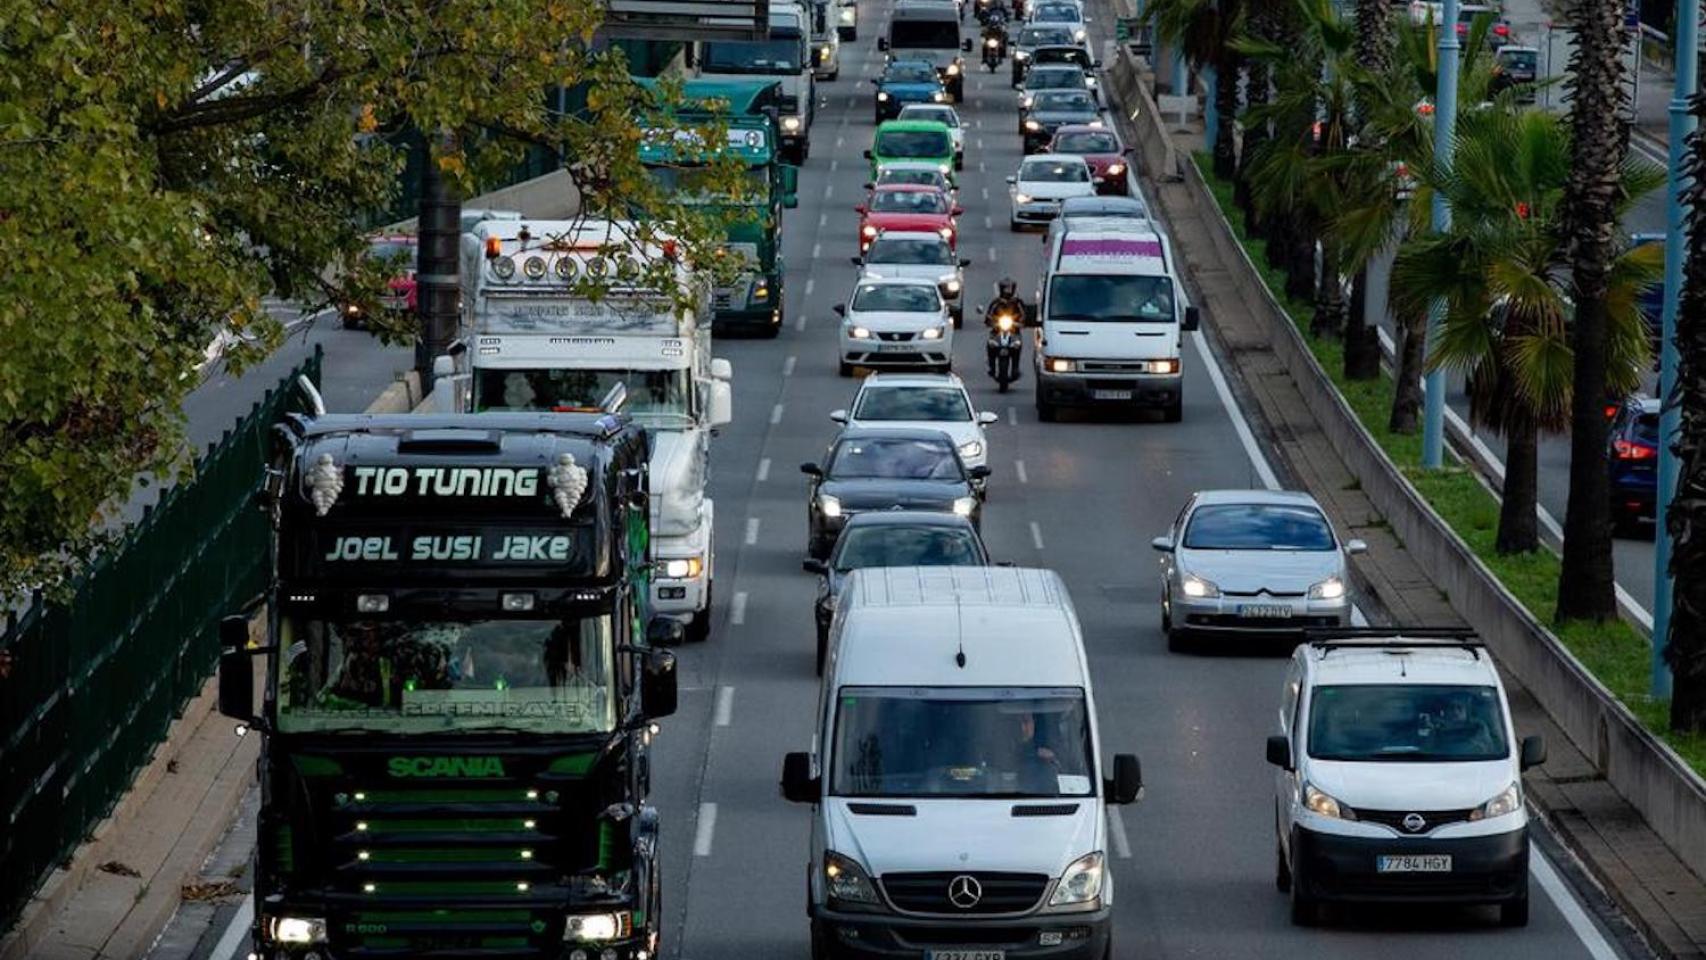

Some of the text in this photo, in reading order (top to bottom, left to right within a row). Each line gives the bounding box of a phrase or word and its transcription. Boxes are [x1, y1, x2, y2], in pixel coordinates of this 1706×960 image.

[355, 467, 538, 496] TIO TUNING
[411, 535, 481, 561] SUSI
[504, 701, 595, 718] RAVEN
[387, 756, 505, 777] SCANIA
[1386, 856, 1449, 869] 7784 HGY
